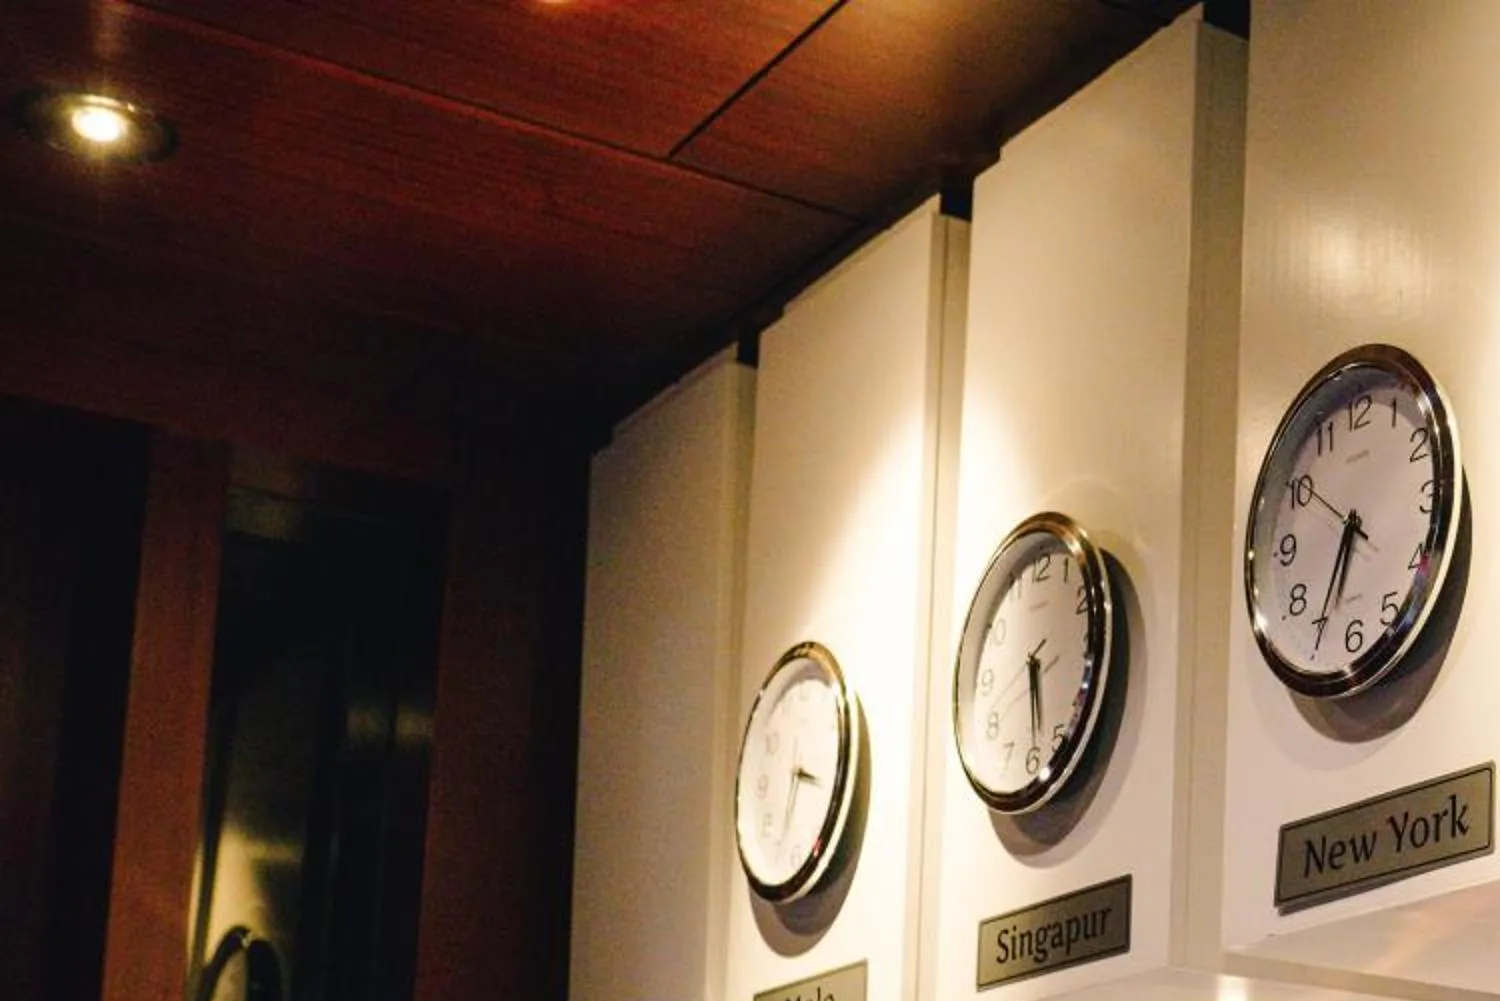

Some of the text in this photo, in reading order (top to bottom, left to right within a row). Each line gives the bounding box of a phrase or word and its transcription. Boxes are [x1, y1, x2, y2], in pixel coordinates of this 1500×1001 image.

[1349, 394, 1372, 431] 12
[1389, 400, 1398, 428] 1
[1315, 421, 1335, 457] 11
[1409, 426, 1429, 464] 2
[1289, 473, 1313, 510] 10
[1279, 532, 1298, 568] 9
[1288, 582, 1308, 618] 8
[1379, 590, 1400, 627] 5
[1344, 619, 1364, 654] 6
[981, 668, 994, 698] 9
[985, 711, 999, 741] 8
[1025, 746, 1041, 776] 6
[1304, 794, 1470, 879] New York
[996, 906, 1113, 964] Singapur
